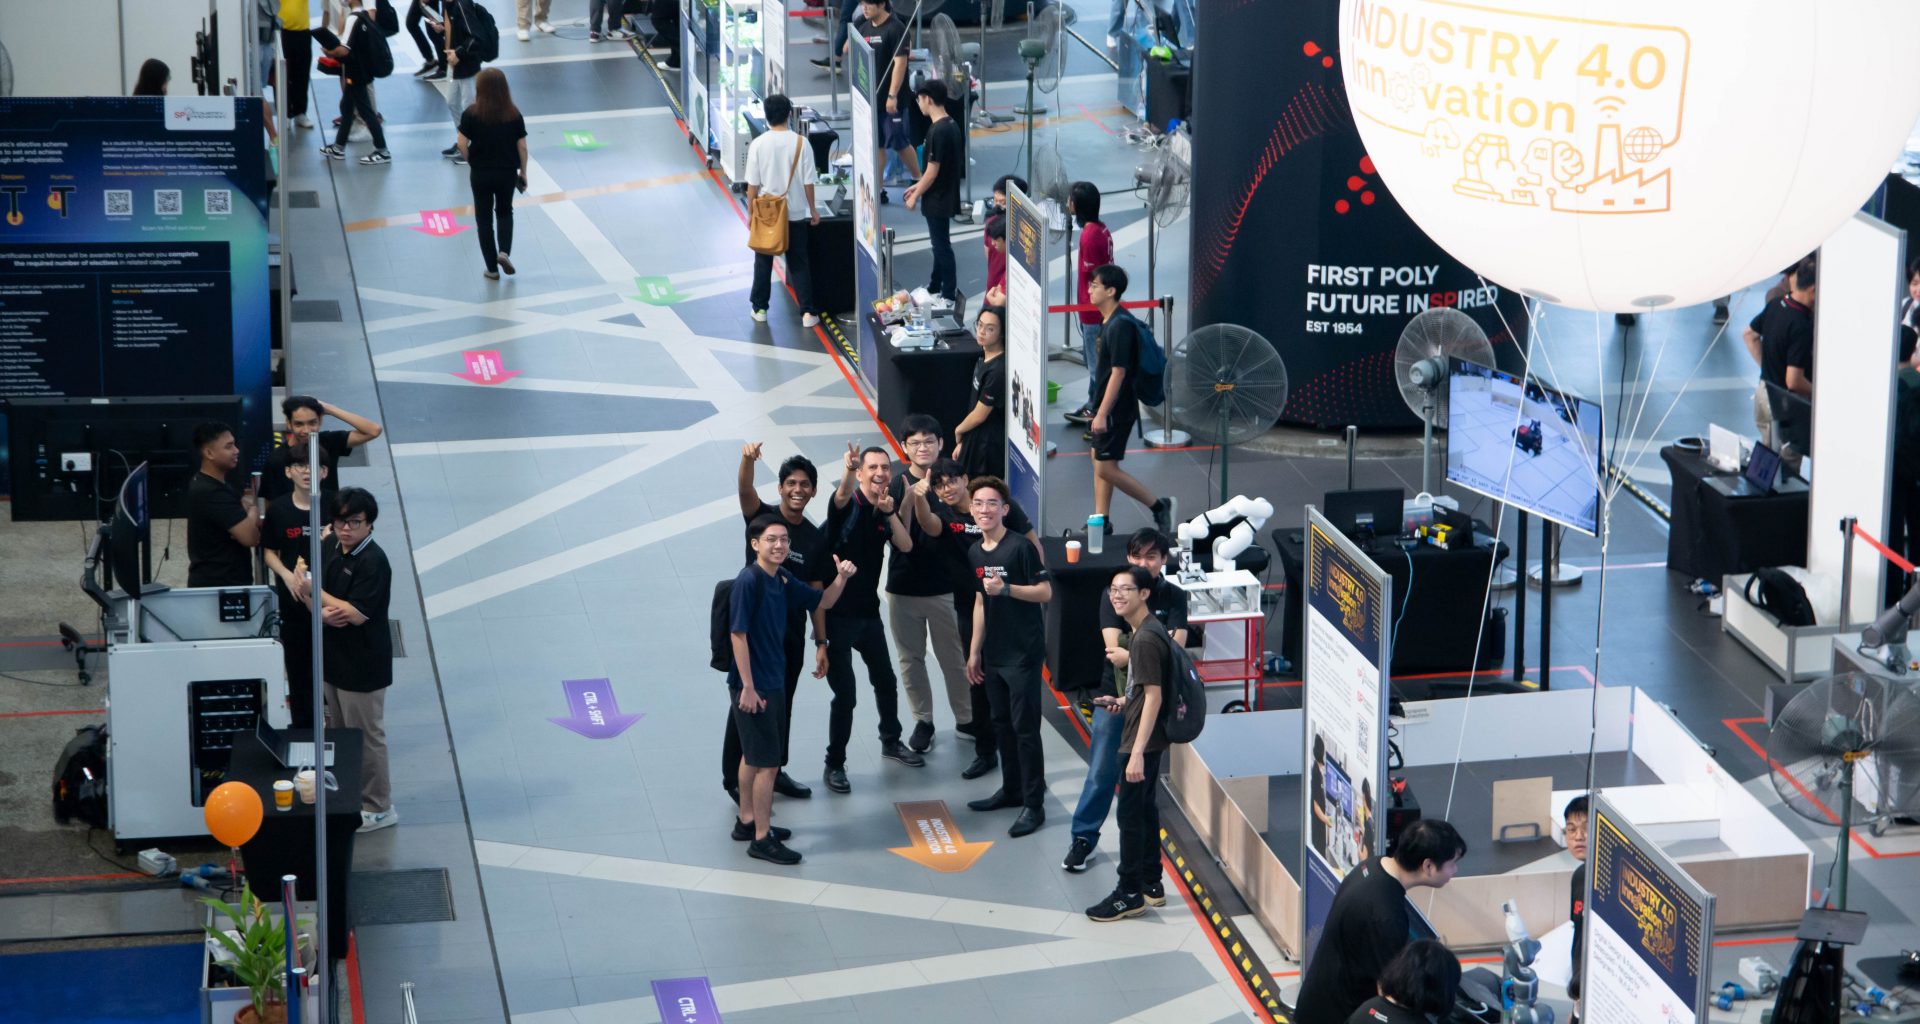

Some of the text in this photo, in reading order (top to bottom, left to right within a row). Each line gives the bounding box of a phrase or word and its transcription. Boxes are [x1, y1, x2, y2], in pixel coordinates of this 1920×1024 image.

[1576, 43, 1666, 91] 4.0
[1308, 264, 1439, 287] FIRST POLY
[1306, 285, 1498, 314] FUTURE INSPIRED
[1306, 320, 1363, 335] EST 1954
[286, 527, 301, 538] SP
[583, 691, 598, 705] CTRL
[588, 710, 605, 726] SHIFT
[916, 819, 943, 855] INNOVATION
[930, 818, 953, 845] INDUSTRY
[1621, 868, 1674, 925] INDUSTRY 4.0
[678, 997, 696, 1017] CTRL
